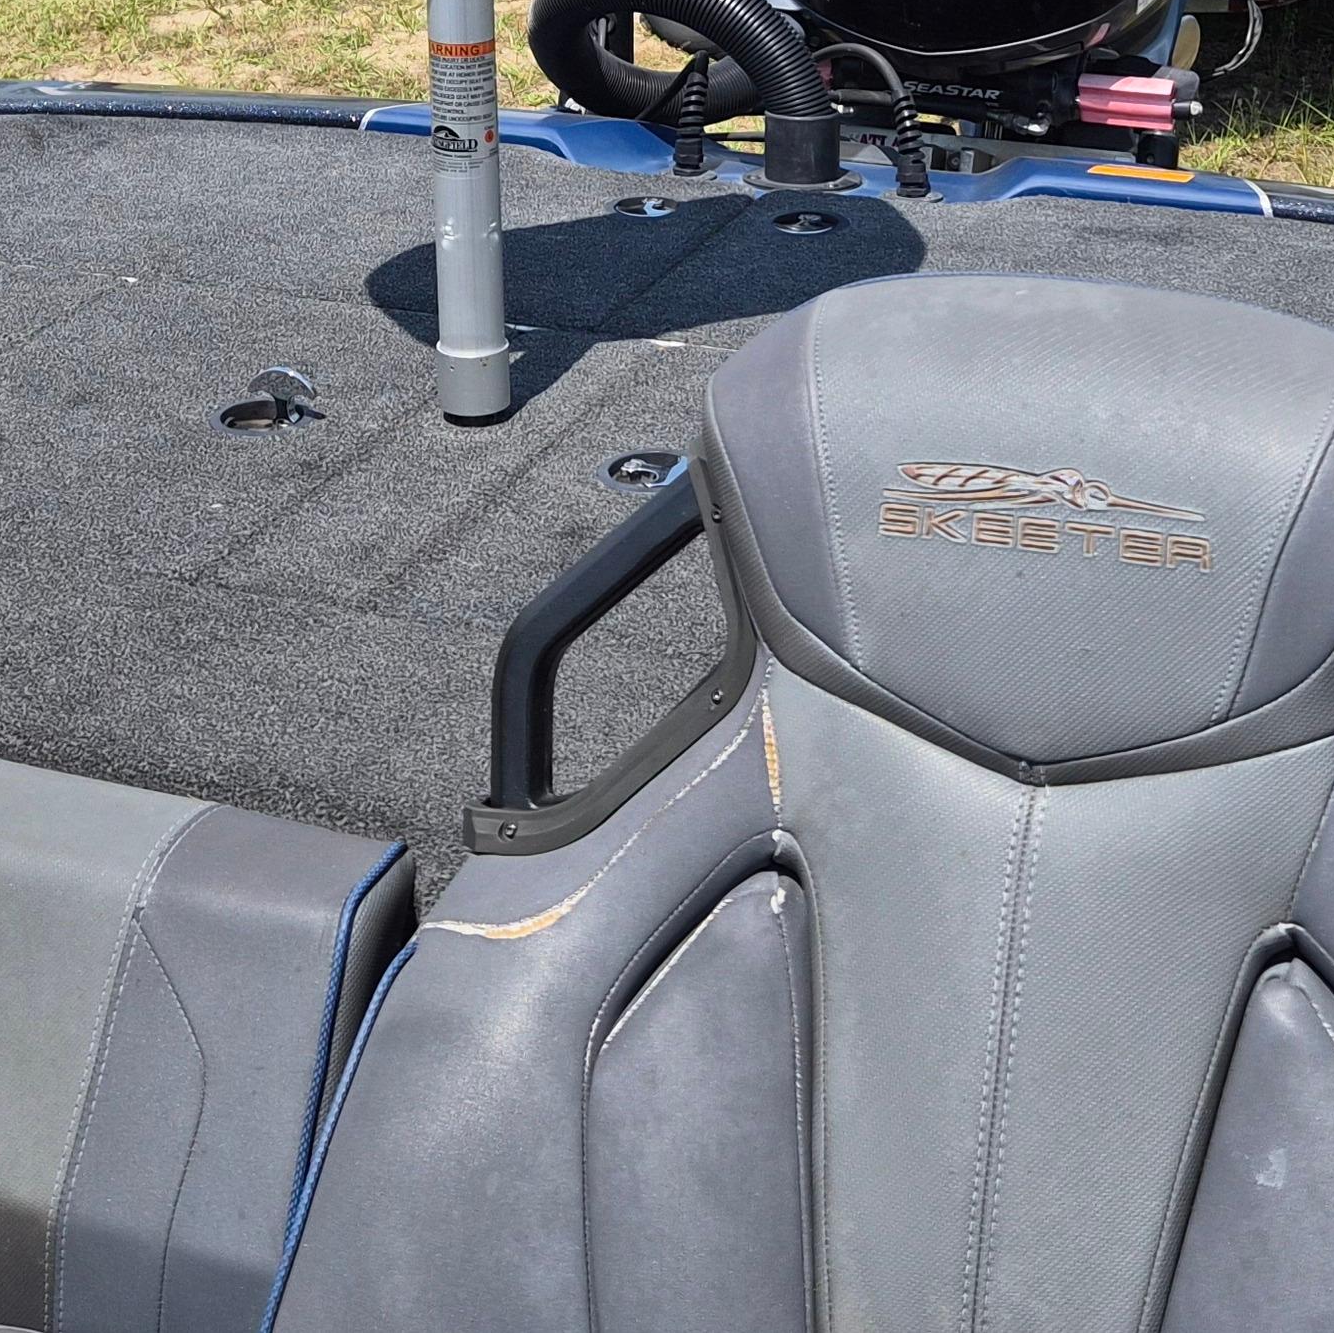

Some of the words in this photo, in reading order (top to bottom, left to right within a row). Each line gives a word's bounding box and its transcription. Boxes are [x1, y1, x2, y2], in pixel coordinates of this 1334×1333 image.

[430, 44, 480, 57] ARNING
[903, 80, 1001, 100] SEASTAR
[878, 501, 1212, 574] SKEETER
